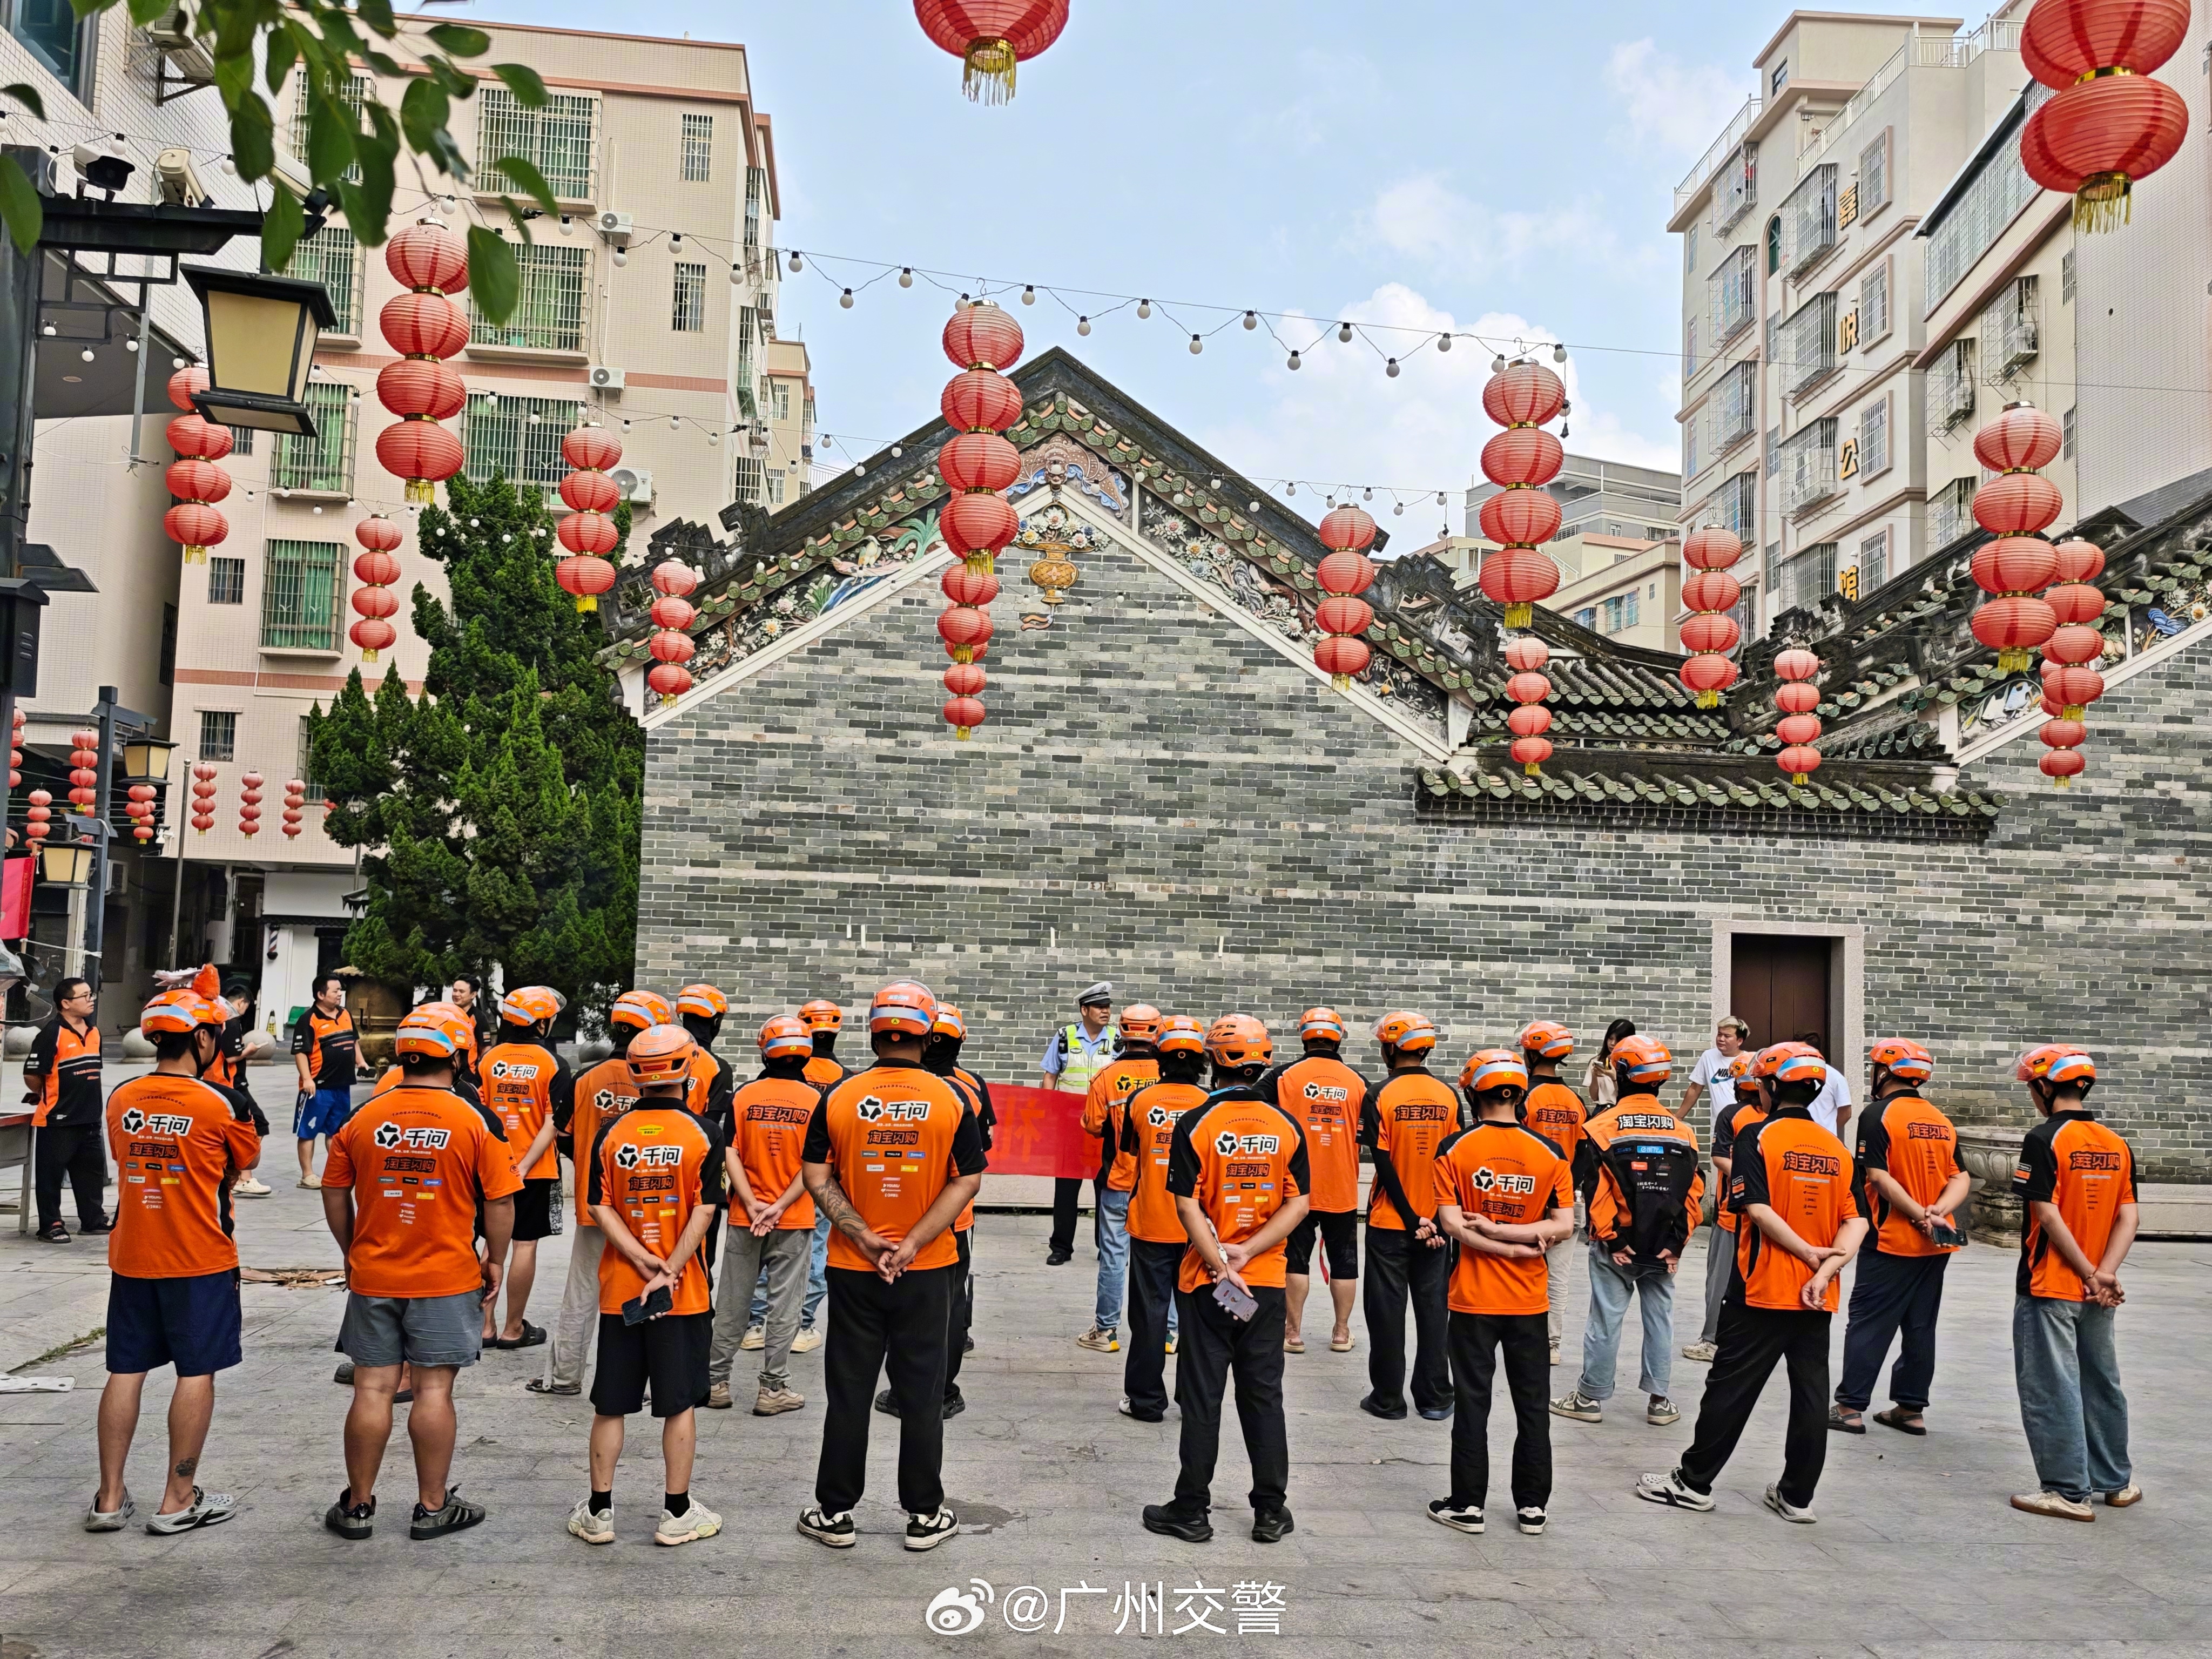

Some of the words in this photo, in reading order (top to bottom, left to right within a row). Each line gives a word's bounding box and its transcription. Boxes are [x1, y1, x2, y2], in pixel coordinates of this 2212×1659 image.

[1838, 181, 1859, 602] 嘉悦公馆
[510, 1066, 537, 1077] 千问
[497, 1083, 529, 1094] 淘宝闪购
[1322, 1088, 1346, 1100] 千问
[617, 1097, 636, 1111] 千
[888, 1102, 928, 1118] 千问
[748, 1105, 809, 1124] 淘宝闪购
[1170, 1111, 1184, 1124] 千
[1395, 1105, 1448, 1121] 淘宝闪购
[1537, 1109, 1579, 1124] 淘宝闪购
[149, 1116, 190, 1134] 千问
[1618, 1114, 1674, 1129] 淘宝闪购
[406, 1130, 448, 1147] 千问
[868, 1130, 918, 1144] 淘宝闪购
[1156, 1133, 1172, 1143] 淘宝
[1908, 1123, 1950, 1140] 淘宝闪购
[131, 1143, 179, 1158] 淘宝闪购
[1242, 1136, 1277, 1152] 千问
[643, 1147, 680, 1164] 千问
[385, 1157, 436, 1172] 淘宝闪购
[1226, 1164, 1269, 1177] 淘宝闪购
[1784, 1151, 1839, 1176] 淘宝闪购
[629, 1176, 674, 1190] 淘宝闪购
[1498, 1176, 1533, 1192] 千问
[1482, 1201, 1525, 1217] 淘宝闪购
